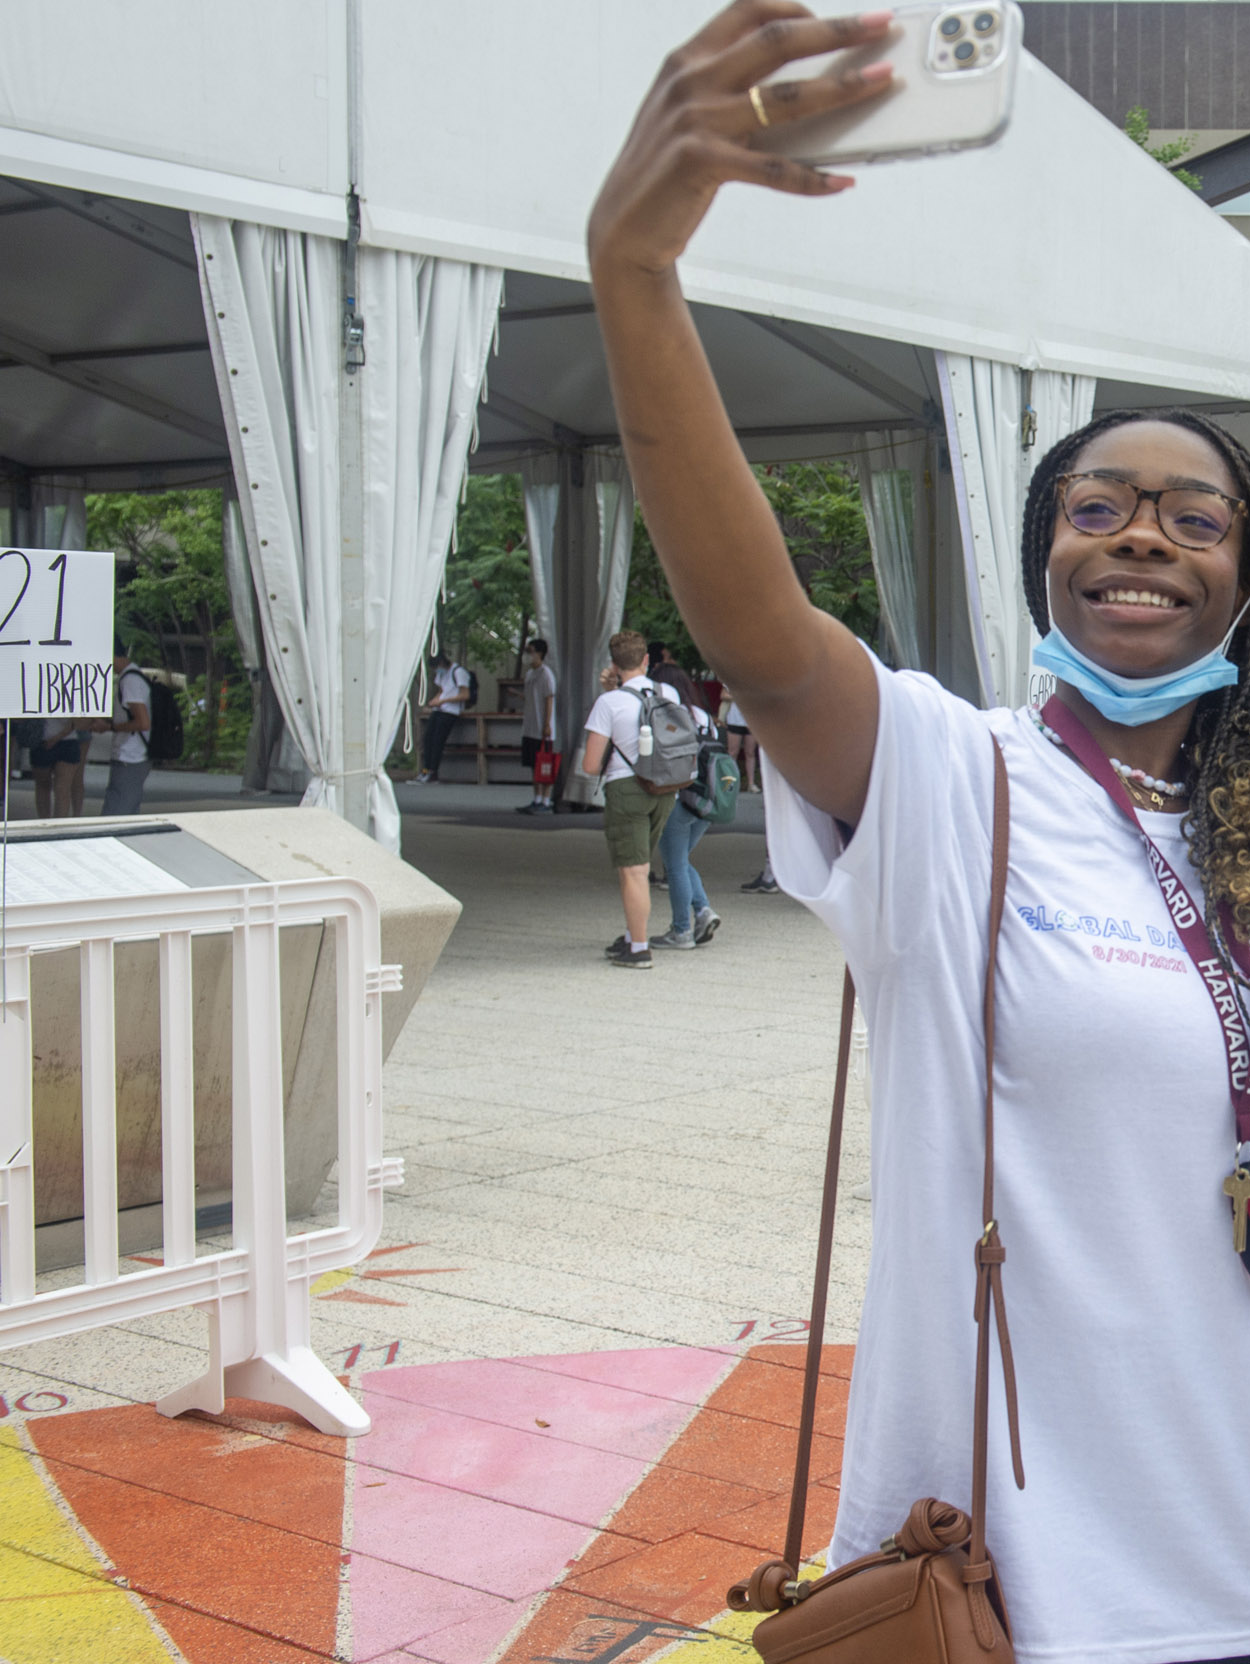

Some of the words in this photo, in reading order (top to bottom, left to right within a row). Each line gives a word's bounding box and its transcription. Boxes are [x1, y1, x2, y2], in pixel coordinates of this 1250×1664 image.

[0, 550, 72, 646] 21
[21, 661, 113, 714] LIBRARY
[1018, 905, 1141, 942] GLOBAL
[1092, 945, 1188, 974] 8/30/2021
[1199, 958, 1250, 1092] HARVARD
[730, 1319, 811, 1341] 12
[332, 1340, 401, 1370] 11
